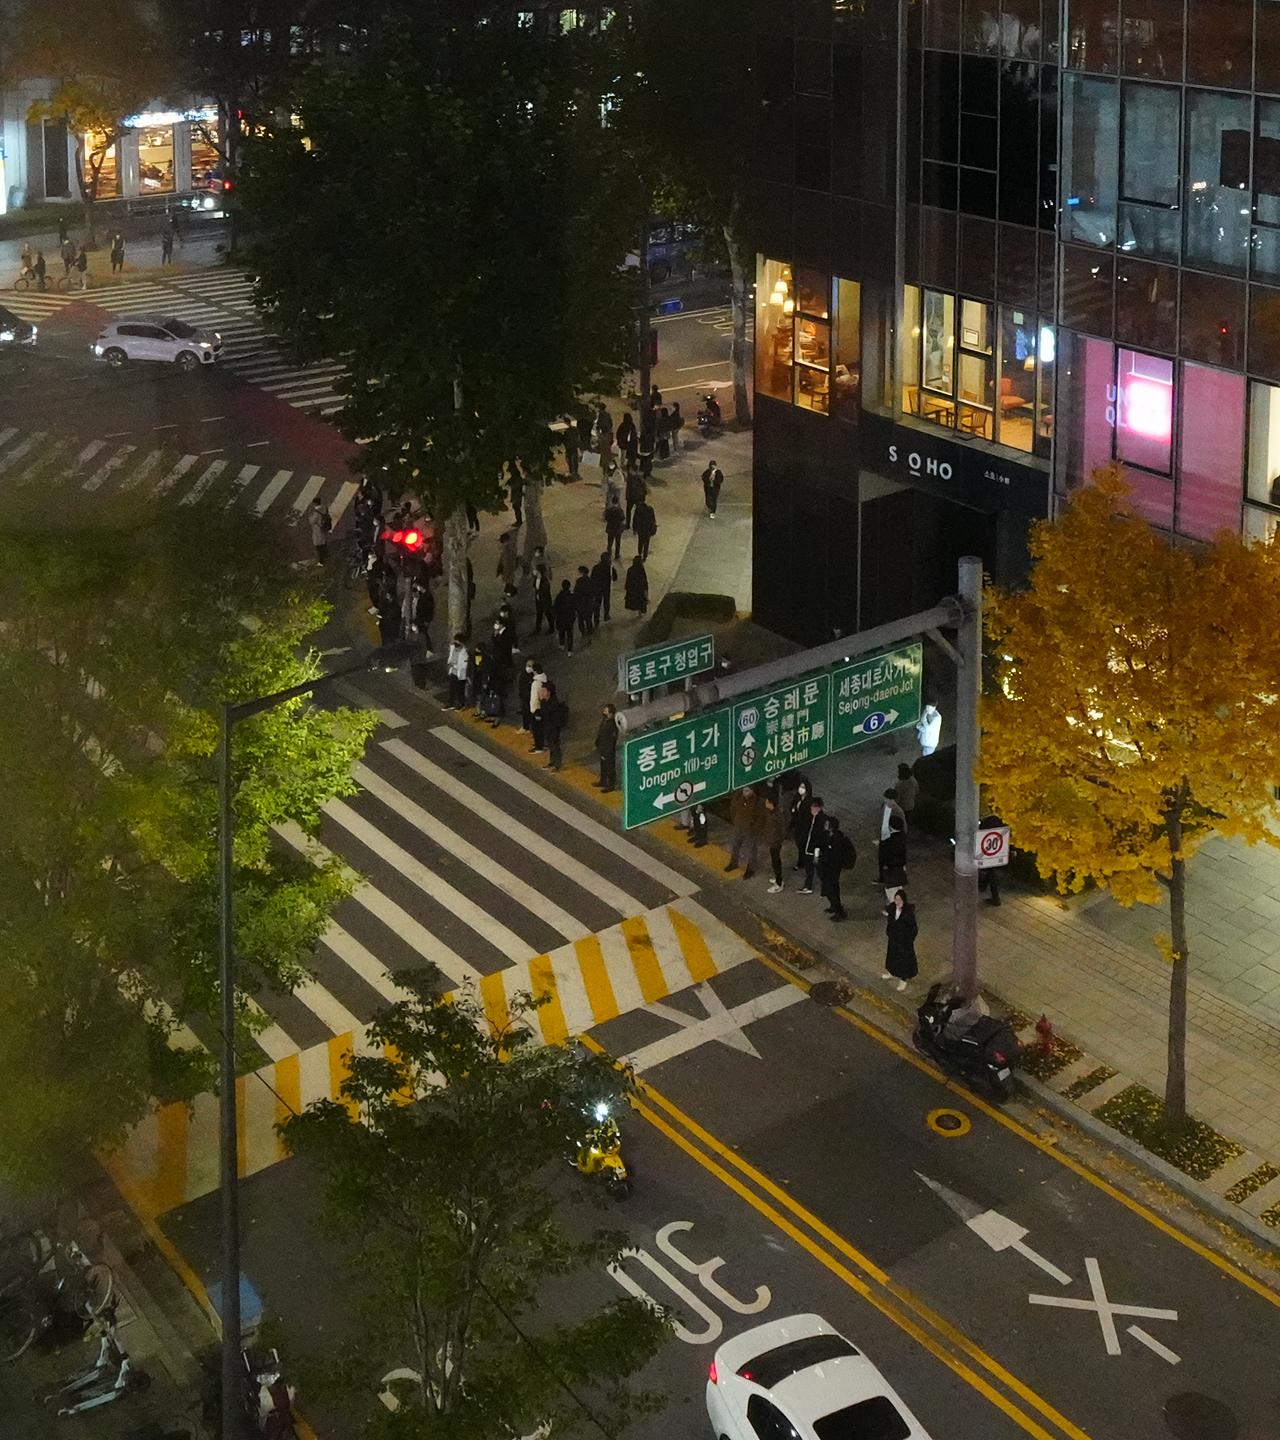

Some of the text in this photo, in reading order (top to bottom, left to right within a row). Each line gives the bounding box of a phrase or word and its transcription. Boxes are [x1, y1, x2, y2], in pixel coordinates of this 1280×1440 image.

[763, 681, 819, 719] 숭례문
[839, 678, 914, 715] Sejong-daero Jct
[742, 713, 756, 727] 60
[870, 715, 879, 730] 6
[637, 723, 720, 772] 종로 1가
[765, 748, 808, 772] City Hall
[639, 767, 681, 791] Jongno
[985, 837, 999, 851] 30
